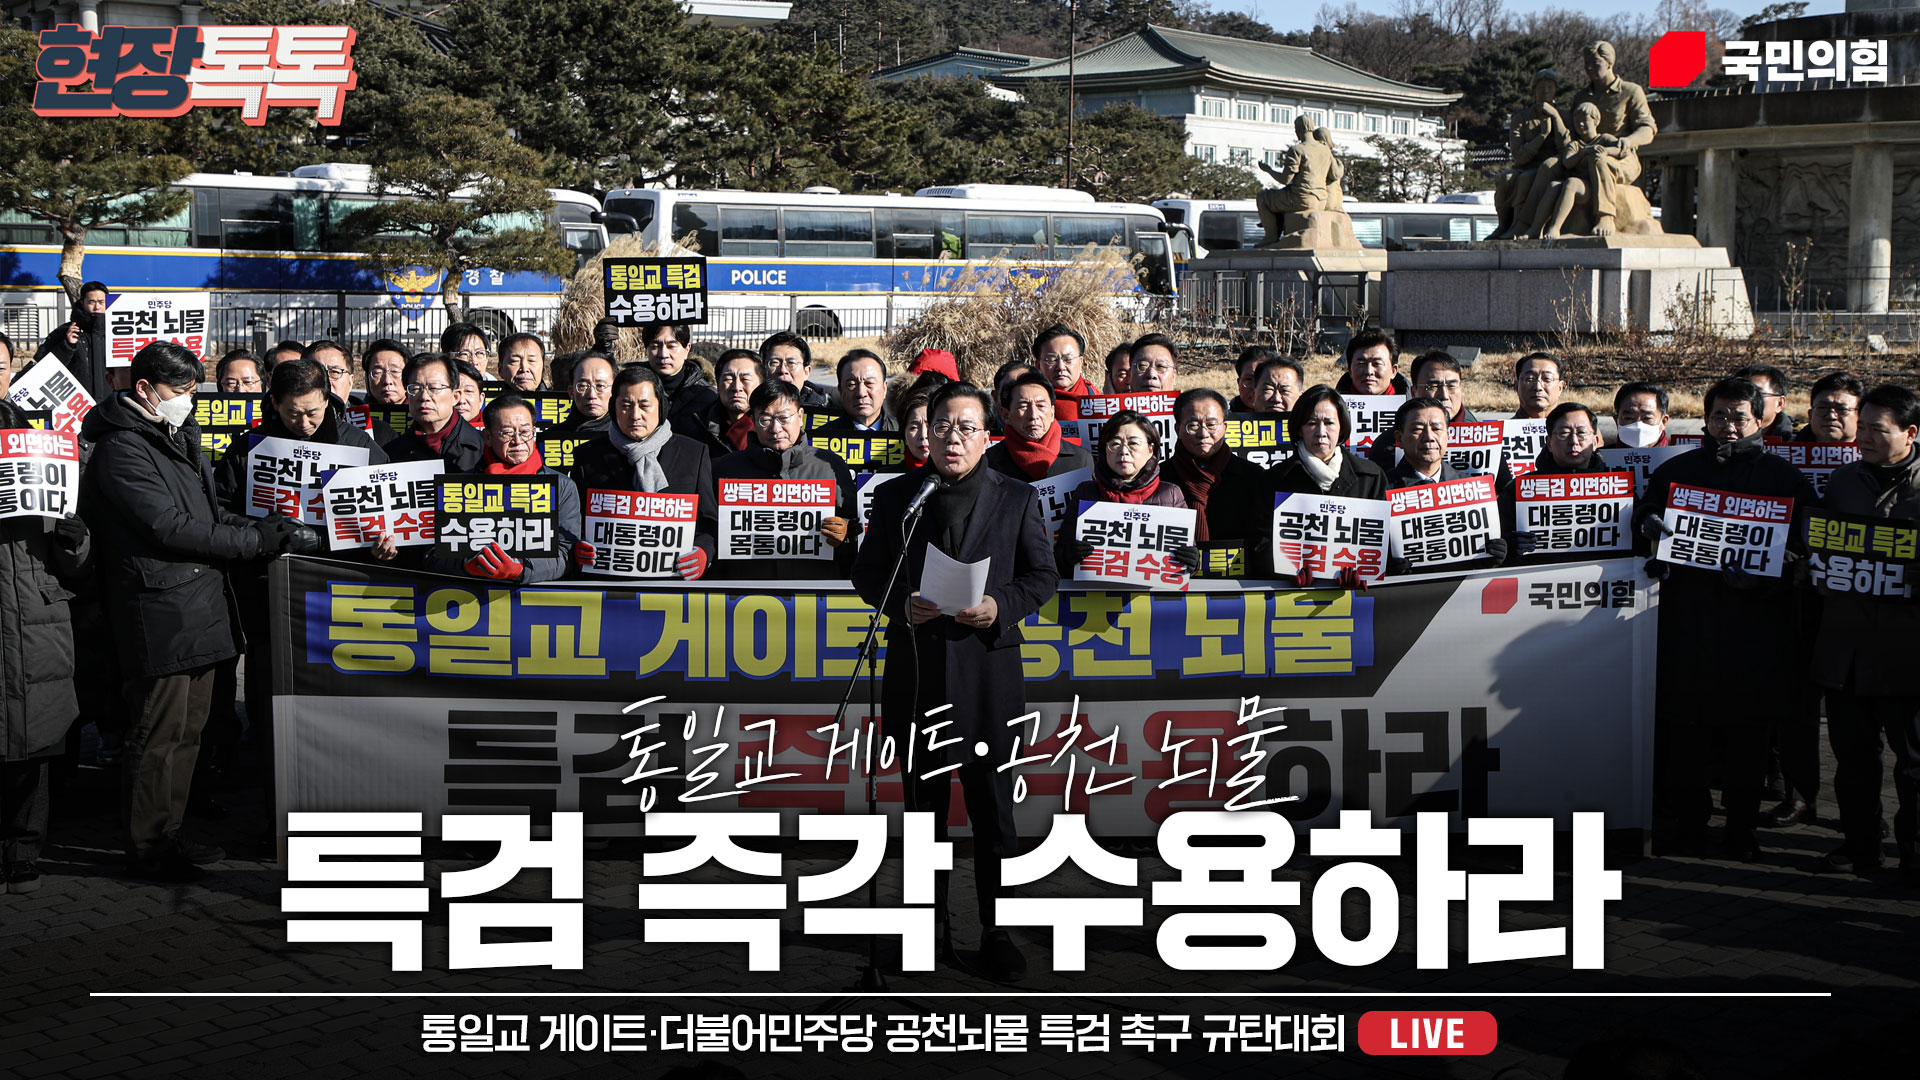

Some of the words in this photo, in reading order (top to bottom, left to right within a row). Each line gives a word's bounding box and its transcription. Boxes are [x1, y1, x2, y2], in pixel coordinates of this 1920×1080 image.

[465, 268, 505, 286] 경찰
[610, 264, 662, 291] 통일교
[666, 263, 701, 289] 특검
[731, 269, 787, 285] POLICE
[147, 300, 172, 309] 민주당
[609, 292, 704, 323] 수용하라
[111, 310, 158, 336] 공천
[163, 309, 205, 335] 뇌물
[194, 399, 247, 426] 통일교
[1080, 397, 1120, 416] 쌍특검
[1124, 394, 1177, 413] 외면하는
[7, 433, 75, 457] 외면하는
[1224, 420, 1277, 448] 통일교
[1448, 424, 1500, 445] 외면하는
[293, 448, 322, 461] 민주당
[544, 439, 591, 467] 통일
[870, 438, 906, 466] 특검
[1443, 449, 1491, 470] 령이
[1623, 453, 1652, 464] 민주당
[1810, 445, 1863, 465] 외면하
[0, 461, 67, 488] 통령이
[253, 453, 303, 488] 공천
[369, 471, 399, 483] 민주당
[329, 484, 384, 516] 공천
[388, 479, 435, 511] 뇌물
[443, 482, 505, 514] 통일교
[509, 483, 551, 514] 특검
[723, 482, 768, 503] 쌍특검
[772, 482, 831, 504] 외면하는
[1390, 487, 1435, 513] 쌍특검
[1436, 480, 1492, 506] 외면하는
[1519, 477, 1566, 499] 쌍특검
[1569, 475, 1629, 497] 외면하는
[0, 488, 68, 515] 통이다
[252, 484, 302, 519] 특검
[306, 493, 326, 521] 수
[590, 493, 631, 515] 쌍특검
[635, 496, 693, 519] 외면하는
[1319, 503, 1347, 514] 민주당
[1527, 502, 1620, 527] 대통령이
[1672, 486, 1721, 513] 쌍특검
[1722, 495, 1788, 520] 외면하는
[333, 515, 388, 544] 특검
[393, 510, 435, 541] 수용
[730, 510, 821, 532] 대통령이
[1123, 511, 1151, 522] 민주당
[1279, 511, 1329, 543] 공천
[1333, 516, 1385, 547] 뇌물
[1400, 507, 1490, 540] 대통령이
[440, 518, 555, 552] 수용하라
[593, 521, 684, 549] 대통령이
[729, 534, 822, 556] 몸통이다
[1082, 518, 1133, 549] 공천
[1137, 523, 1189, 553] 뇌물
[1529, 526, 1621, 550] 몸통이다
[1674, 514, 1775, 548] 대통령이
[1807, 516, 1867, 554] 통일교
[1871, 525, 1918, 560] 특검
[1279, 541, 1327, 574] 특검
[1332, 547, 1382, 577] 수용
[1402, 532, 1490, 563] 몸통이다
[1670, 537, 1771, 573] 몸통이다
[1080, 548, 1130, 578] 특검
[1135, 552, 1186, 585] 수용
[1208, 547, 1245, 577] 특검
[1528, 579, 1636, 610] 국민의힘
[328, 582, 607, 678] 통일교
[635, 590, 888, 679] 게이트
[1182, 590, 1355, 677] 뇌물
[443, 709, 688, 826] 특검
